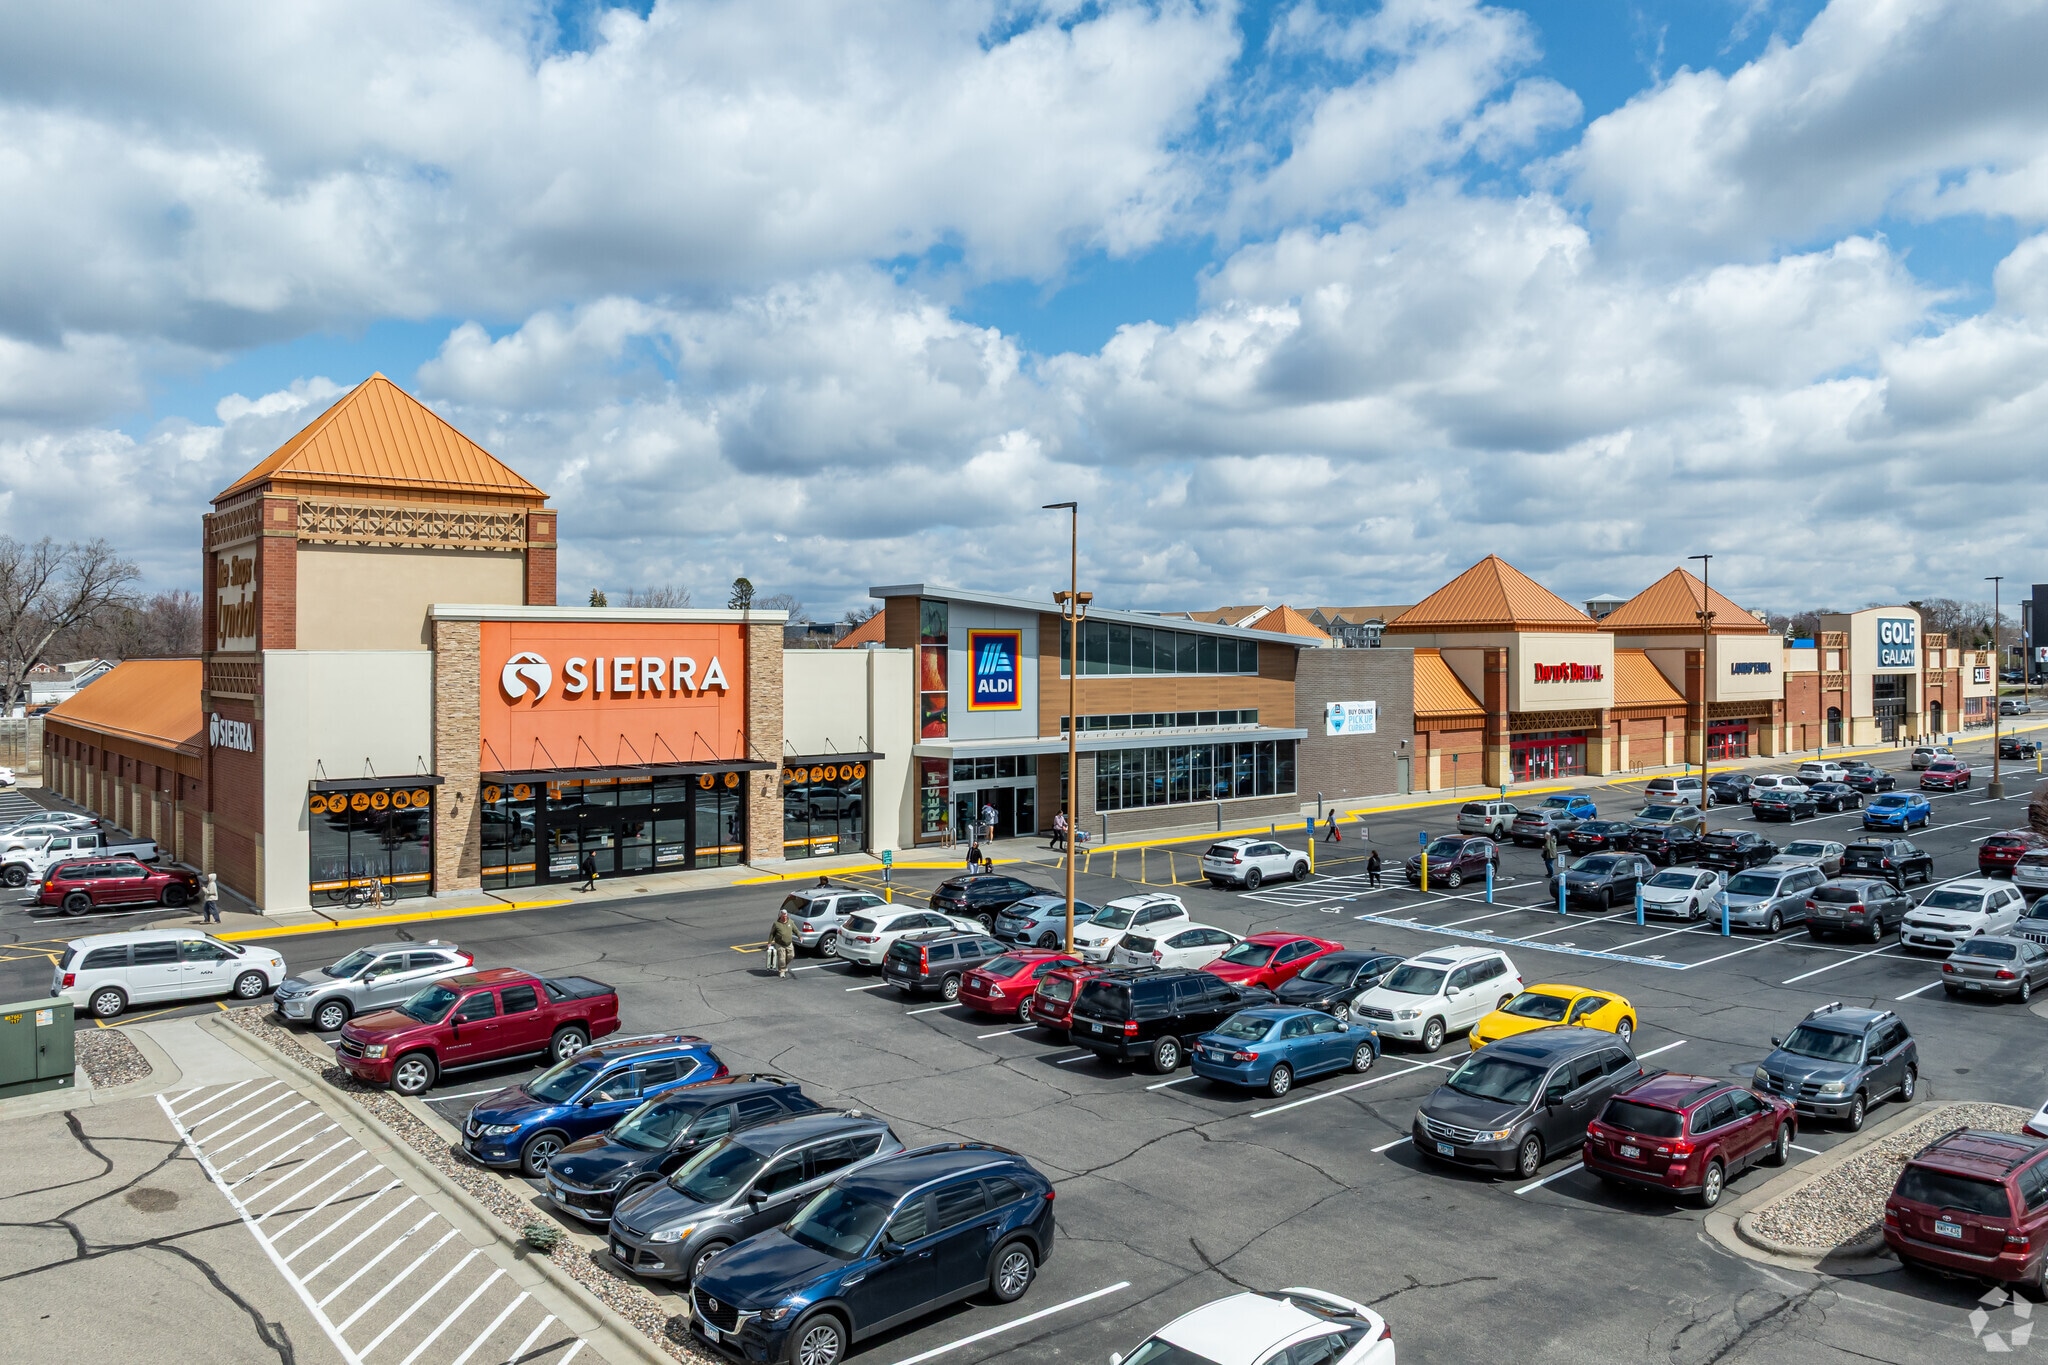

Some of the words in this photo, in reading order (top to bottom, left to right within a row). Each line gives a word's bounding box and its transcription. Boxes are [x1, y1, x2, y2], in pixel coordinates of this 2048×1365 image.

[1881, 621, 1915, 644] GOLF
[1881, 648, 1915, 665] GALAXY
[564, 655, 730, 694] SIERRA
[977, 678, 1013, 693] ALDI
[1348, 715, 1363, 724] PICK
[1364, 714, 1374, 723] UP
[1348, 723, 1374, 732] CURBSIDE
[219, 718, 253, 753] SIERRA
[927, 771, 940, 832] FRESH
